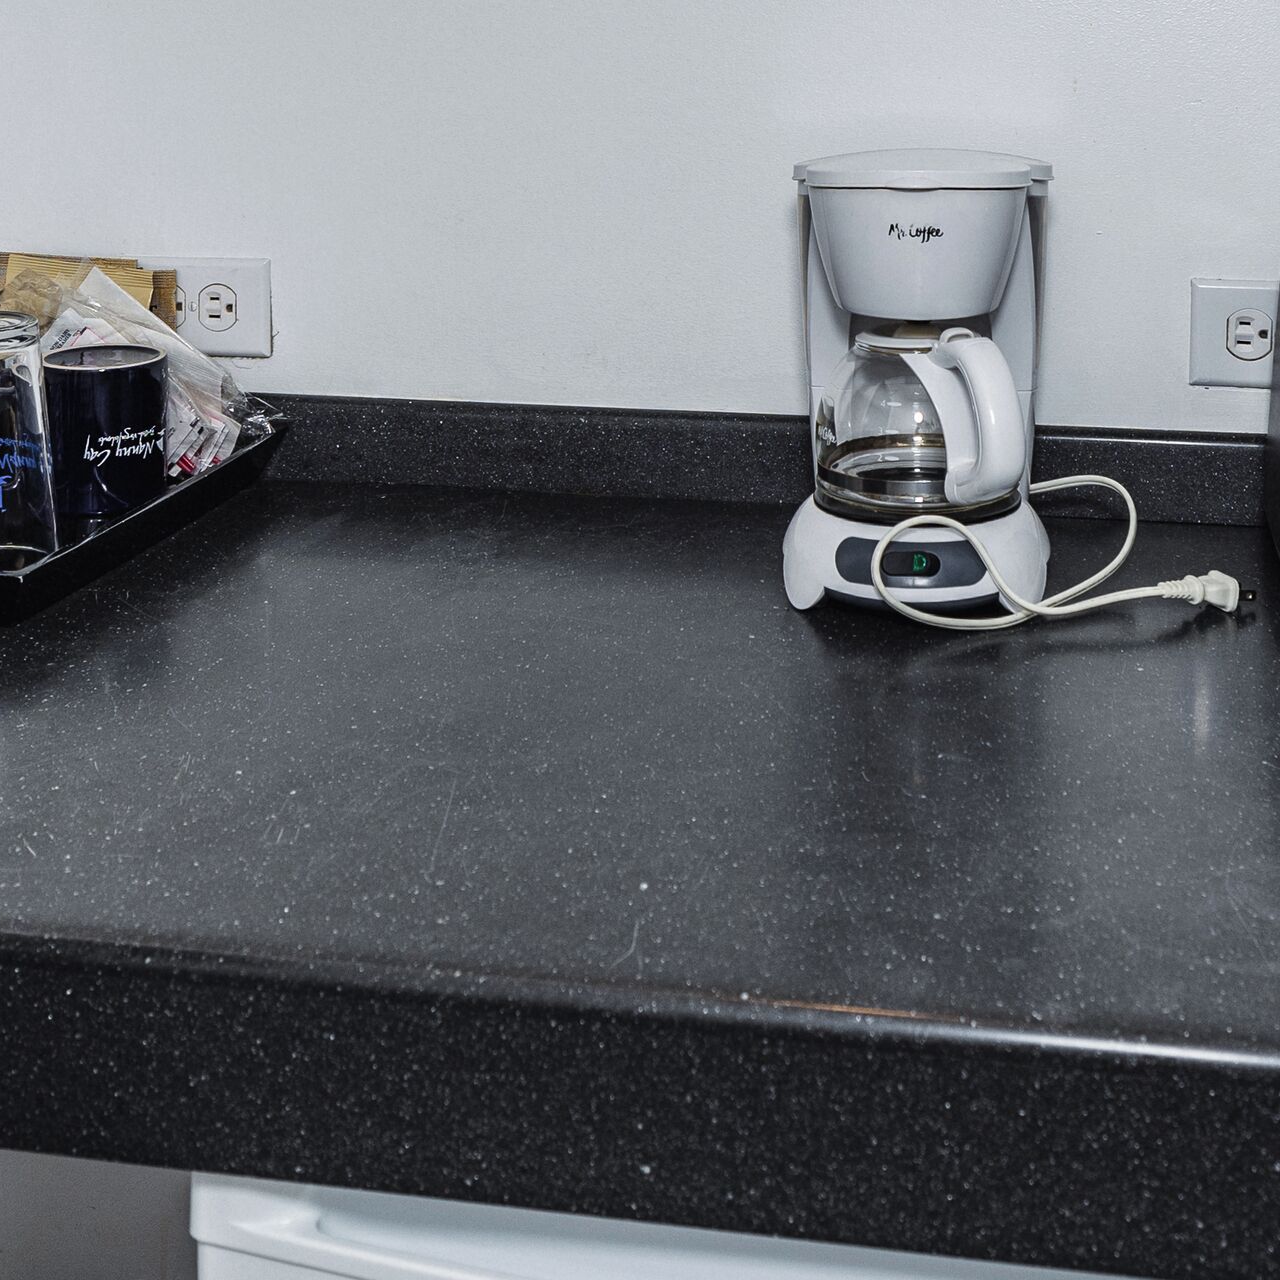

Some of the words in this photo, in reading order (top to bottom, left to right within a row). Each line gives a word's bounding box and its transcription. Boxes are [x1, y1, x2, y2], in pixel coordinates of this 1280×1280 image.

[908, 223, 944, 244] Coffee
[83, 433, 111, 467] Cay
[115, 431, 155, 460] Nanny
